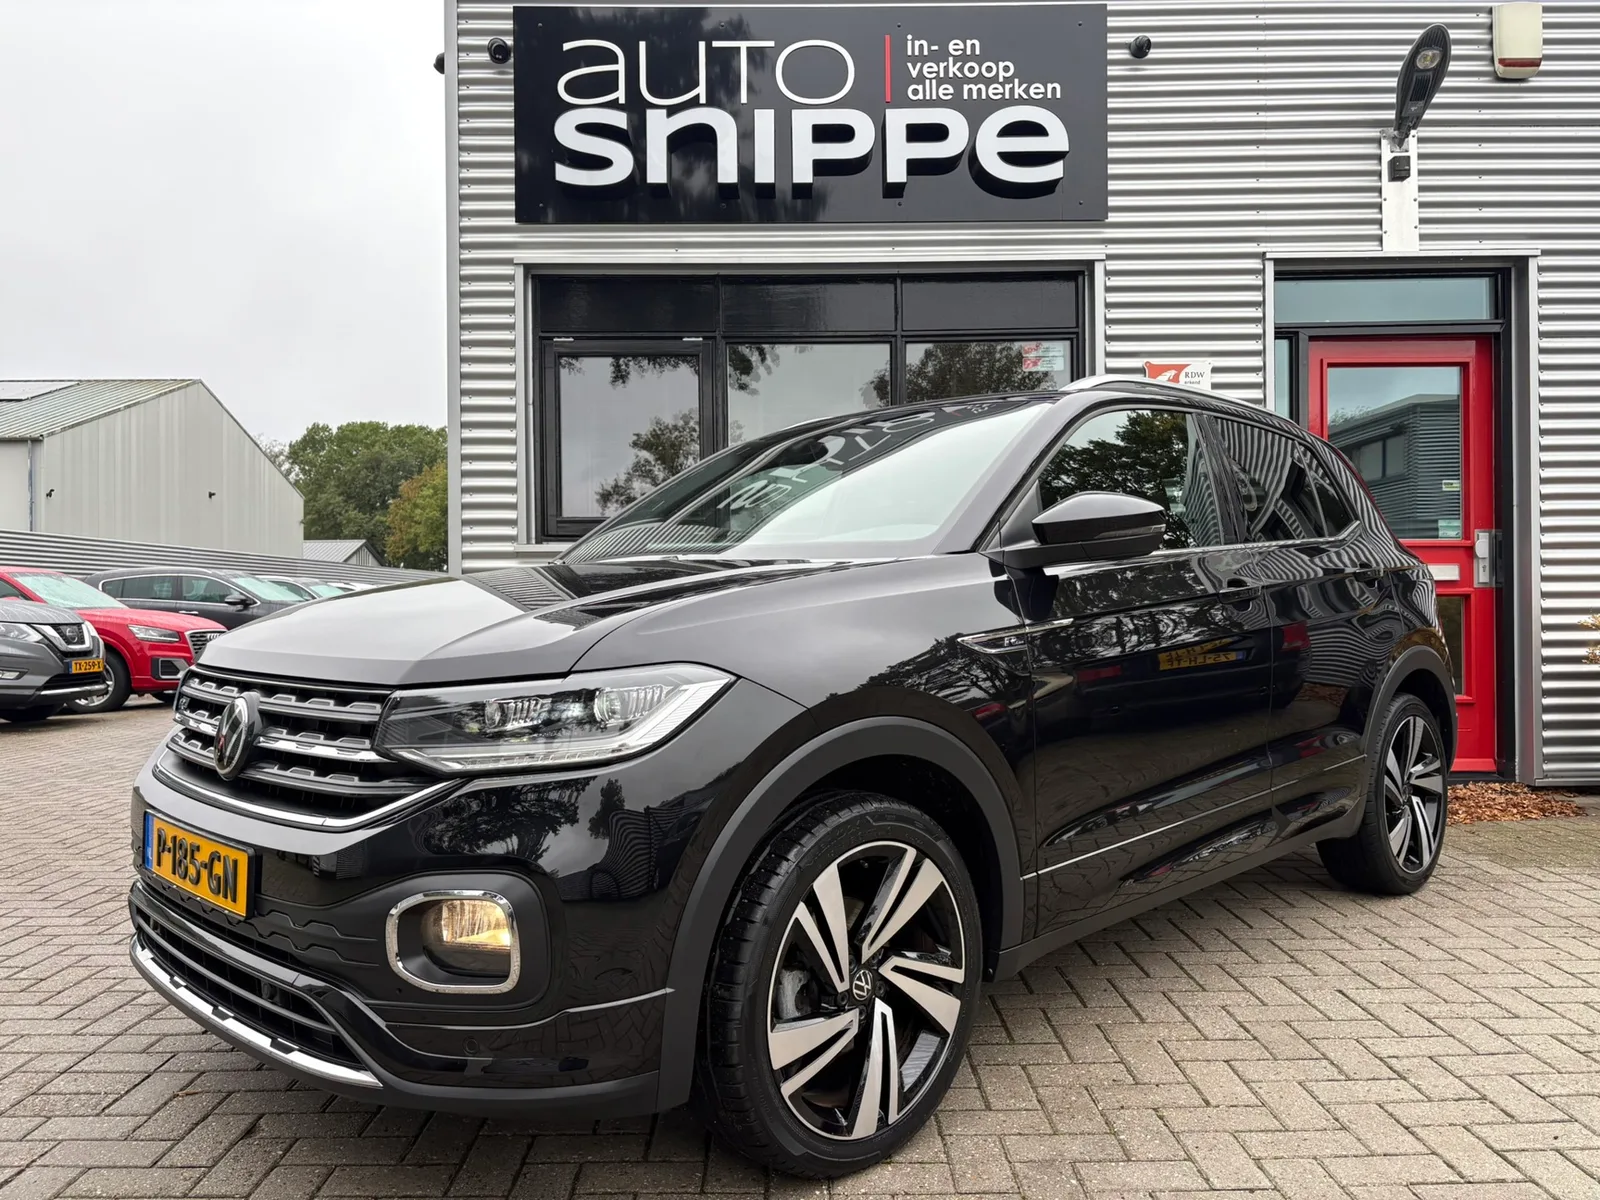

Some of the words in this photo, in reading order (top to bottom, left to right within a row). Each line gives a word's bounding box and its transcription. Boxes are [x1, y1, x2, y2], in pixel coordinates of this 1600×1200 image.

[906, 34, 939, 56] in-
[948, 39, 981, 56] en
[906, 57, 1015, 83] verkoop
[907, 79, 955, 101] alle
[962, 78, 1062, 100] merken
[1184, 371, 1206, 379] RDW
[156, 827, 239, 904] P-185-GN
